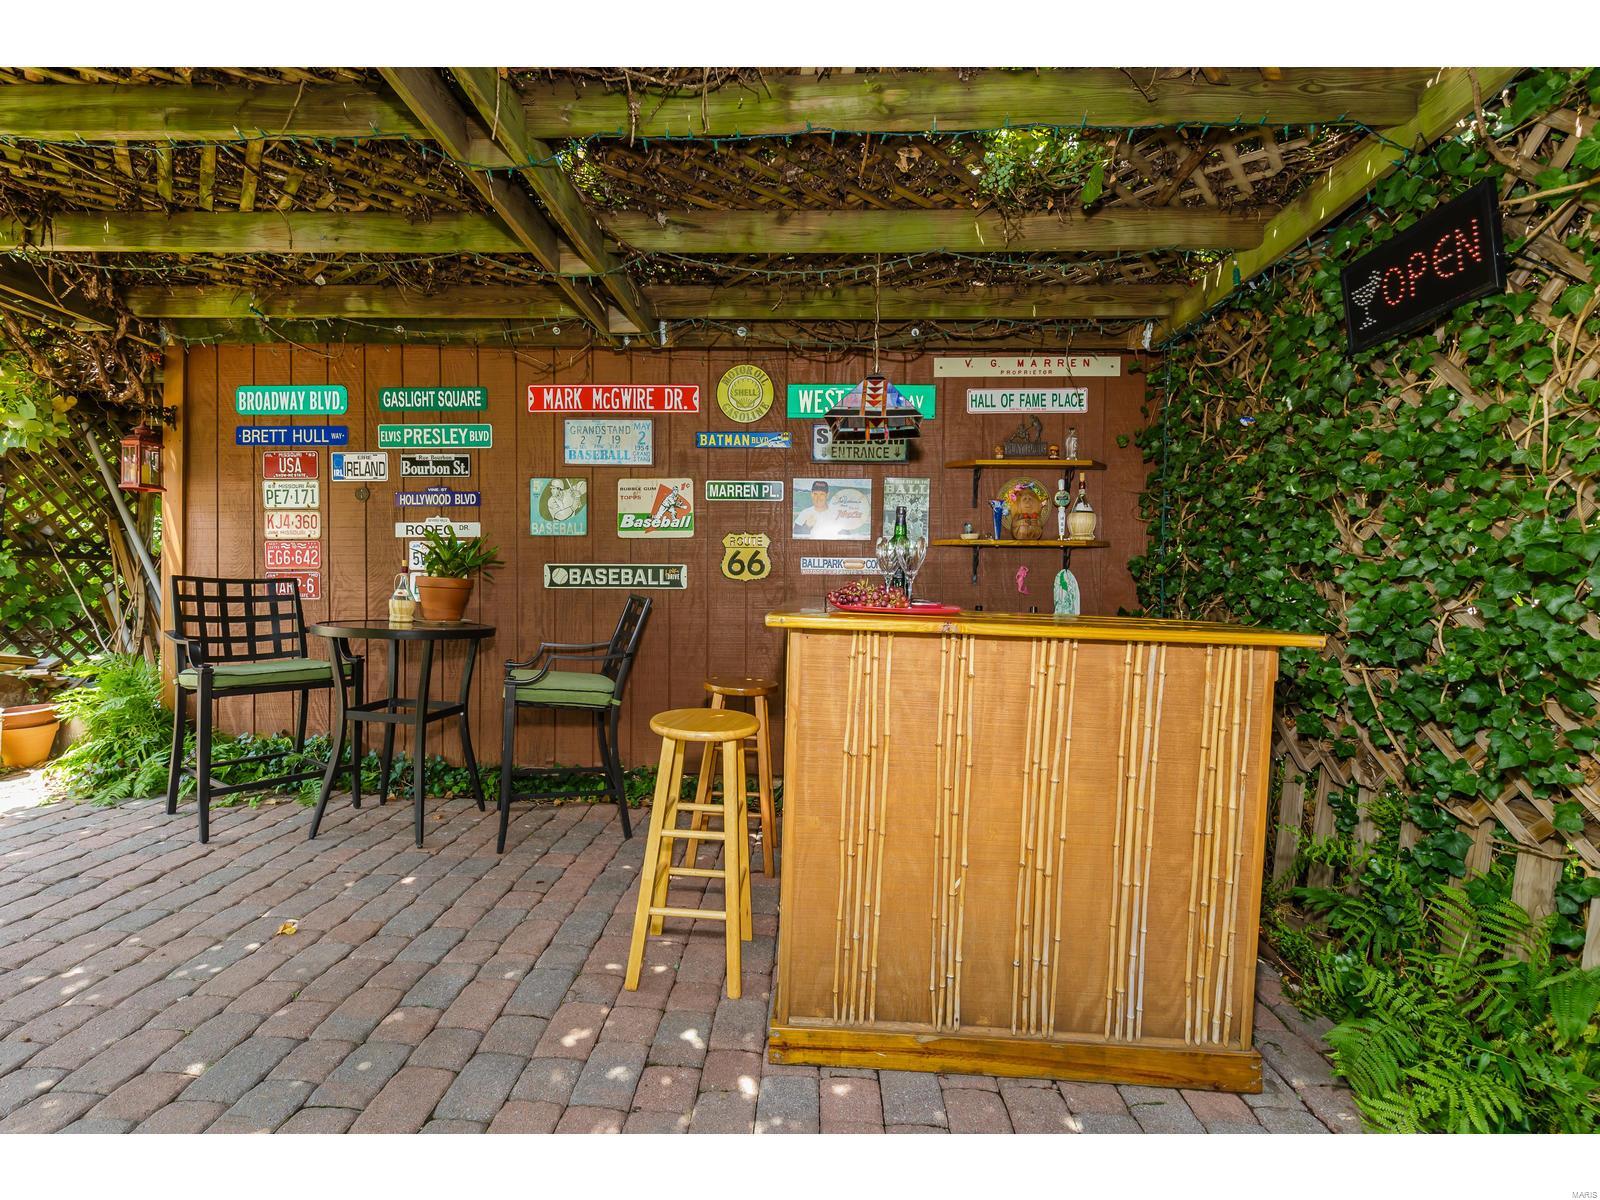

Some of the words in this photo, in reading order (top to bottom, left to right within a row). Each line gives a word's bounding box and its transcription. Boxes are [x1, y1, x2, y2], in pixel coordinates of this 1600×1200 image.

[1382, 218, 1483, 306] OPEN
[965, 360, 974, 368] V.
[1017, 359, 1091, 368] MARREN
[721, 366, 753, 385] MOTOR
[754, 370, 769, 386] OIL
[383, 391, 435, 408] GASLIGHT
[438, 391, 481, 408] SQUARE
[543, 388, 582, 410] MARK
[592, 388, 655, 410] McGWIRE
[664, 388, 688, 410] DR.
[734, 389, 758, 397] SHELL
[238, 391, 305, 411] BROADWAY
[309, 391, 345, 411] BLVD.
[970, 393, 996, 408] HALL
[1000, 393, 1014, 408] OF
[1019, 393, 1047, 408] FAME
[1051, 393, 1085, 408] PLACE
[722, 402, 770, 421] GASOLINE
[570, 425, 631, 435] GRANDSTAND
[633, 422, 651, 430] MAY
[242, 429, 287, 443] BRETT
[292, 429, 329, 443] HULL
[330, 432, 343, 440] WAY
[380, 430, 402, 442] ELVIS
[403, 428, 469, 445] PRESLEY
[469, 430, 490, 442] BLVD
[580, 436, 586, 445] 2
[596, 436, 602, 445] 7
[638, 431, 646, 445] 2
[700, 434, 750, 447] BATMAN
[568, 449, 631, 460] BASEBALL
[831, 447, 890, 459] ENTRANCE
[279, 458, 302, 473] USA
[344, 461, 386, 477] IRELAND
[402, 460, 450, 475] Bourbon
[453, 460, 469, 475] St.
[333, 469, 344, 477] IRL
[709, 484, 759, 497] MARREN
[762, 484, 780, 498] PL.
[399, 494, 451, 505] HOLLYWOOD
[454, 493, 477, 505] BLVD
[620, 513, 693, 529] Baseball
[531, 522, 587, 535] BASEBALL
[729, 536, 763, 546] ROUTE
[728, 549, 766, 576] 66
[801, 558, 844, 569] BALLPARK
[569, 568, 671, 585] BASEBALL
